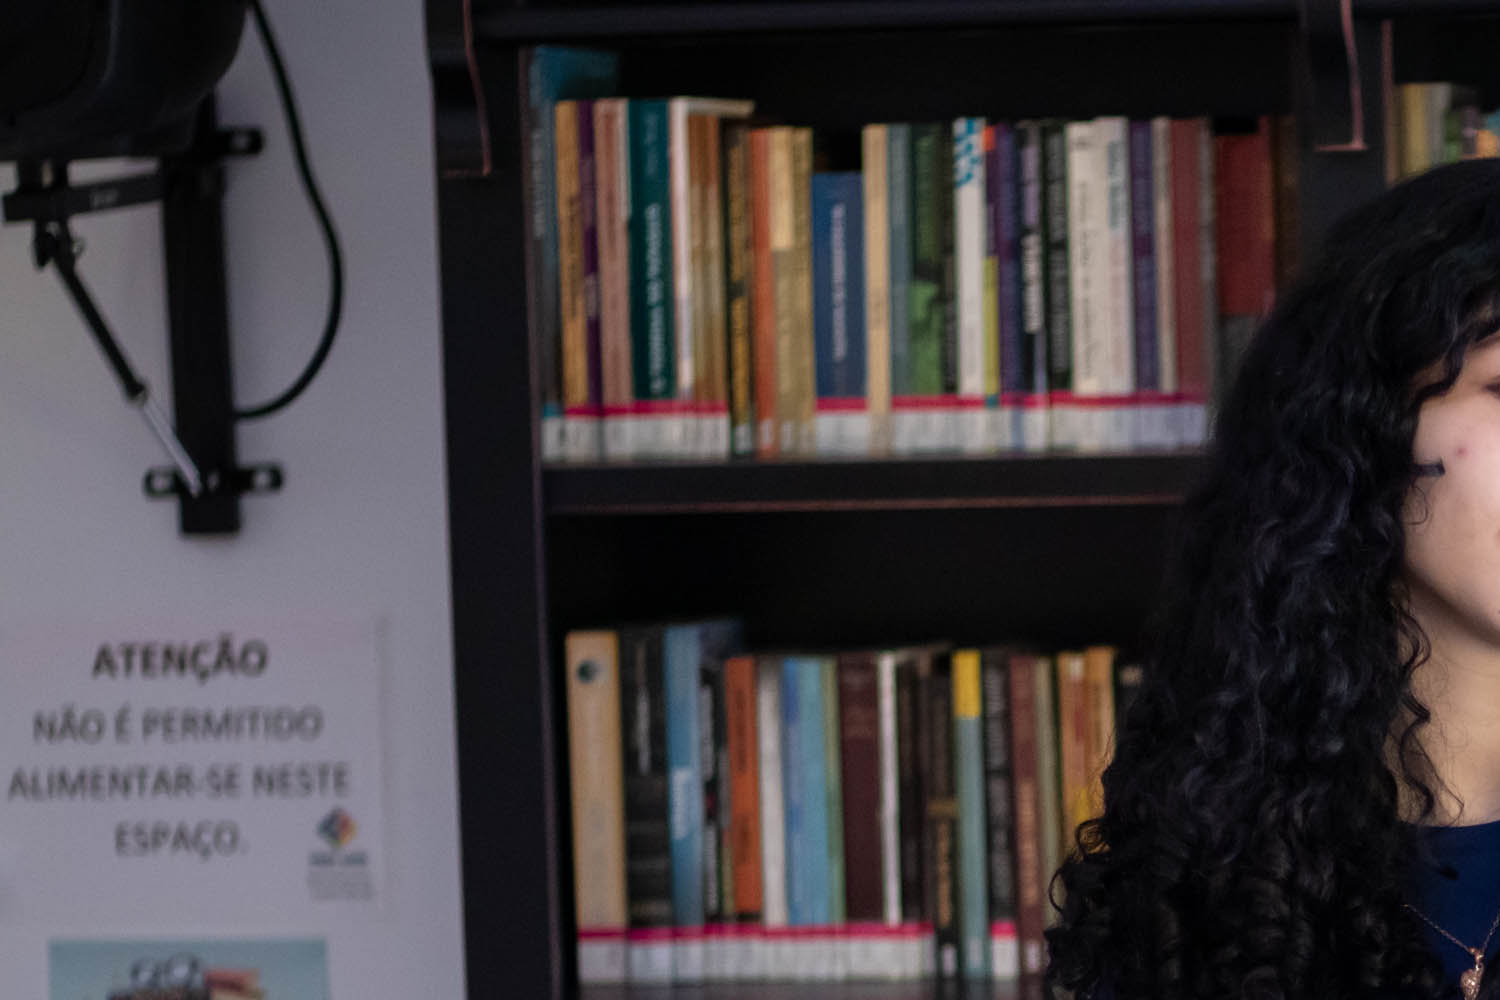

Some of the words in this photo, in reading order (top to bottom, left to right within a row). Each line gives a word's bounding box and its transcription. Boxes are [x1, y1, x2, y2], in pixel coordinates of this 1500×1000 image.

[92, 632, 269, 685] ATENÇÃO
[33, 702, 104, 743] NÃO
[114, 701, 131, 742] É
[142, 704, 324, 742] PERMITIDO
[252, 761, 350, 797] NESTE
